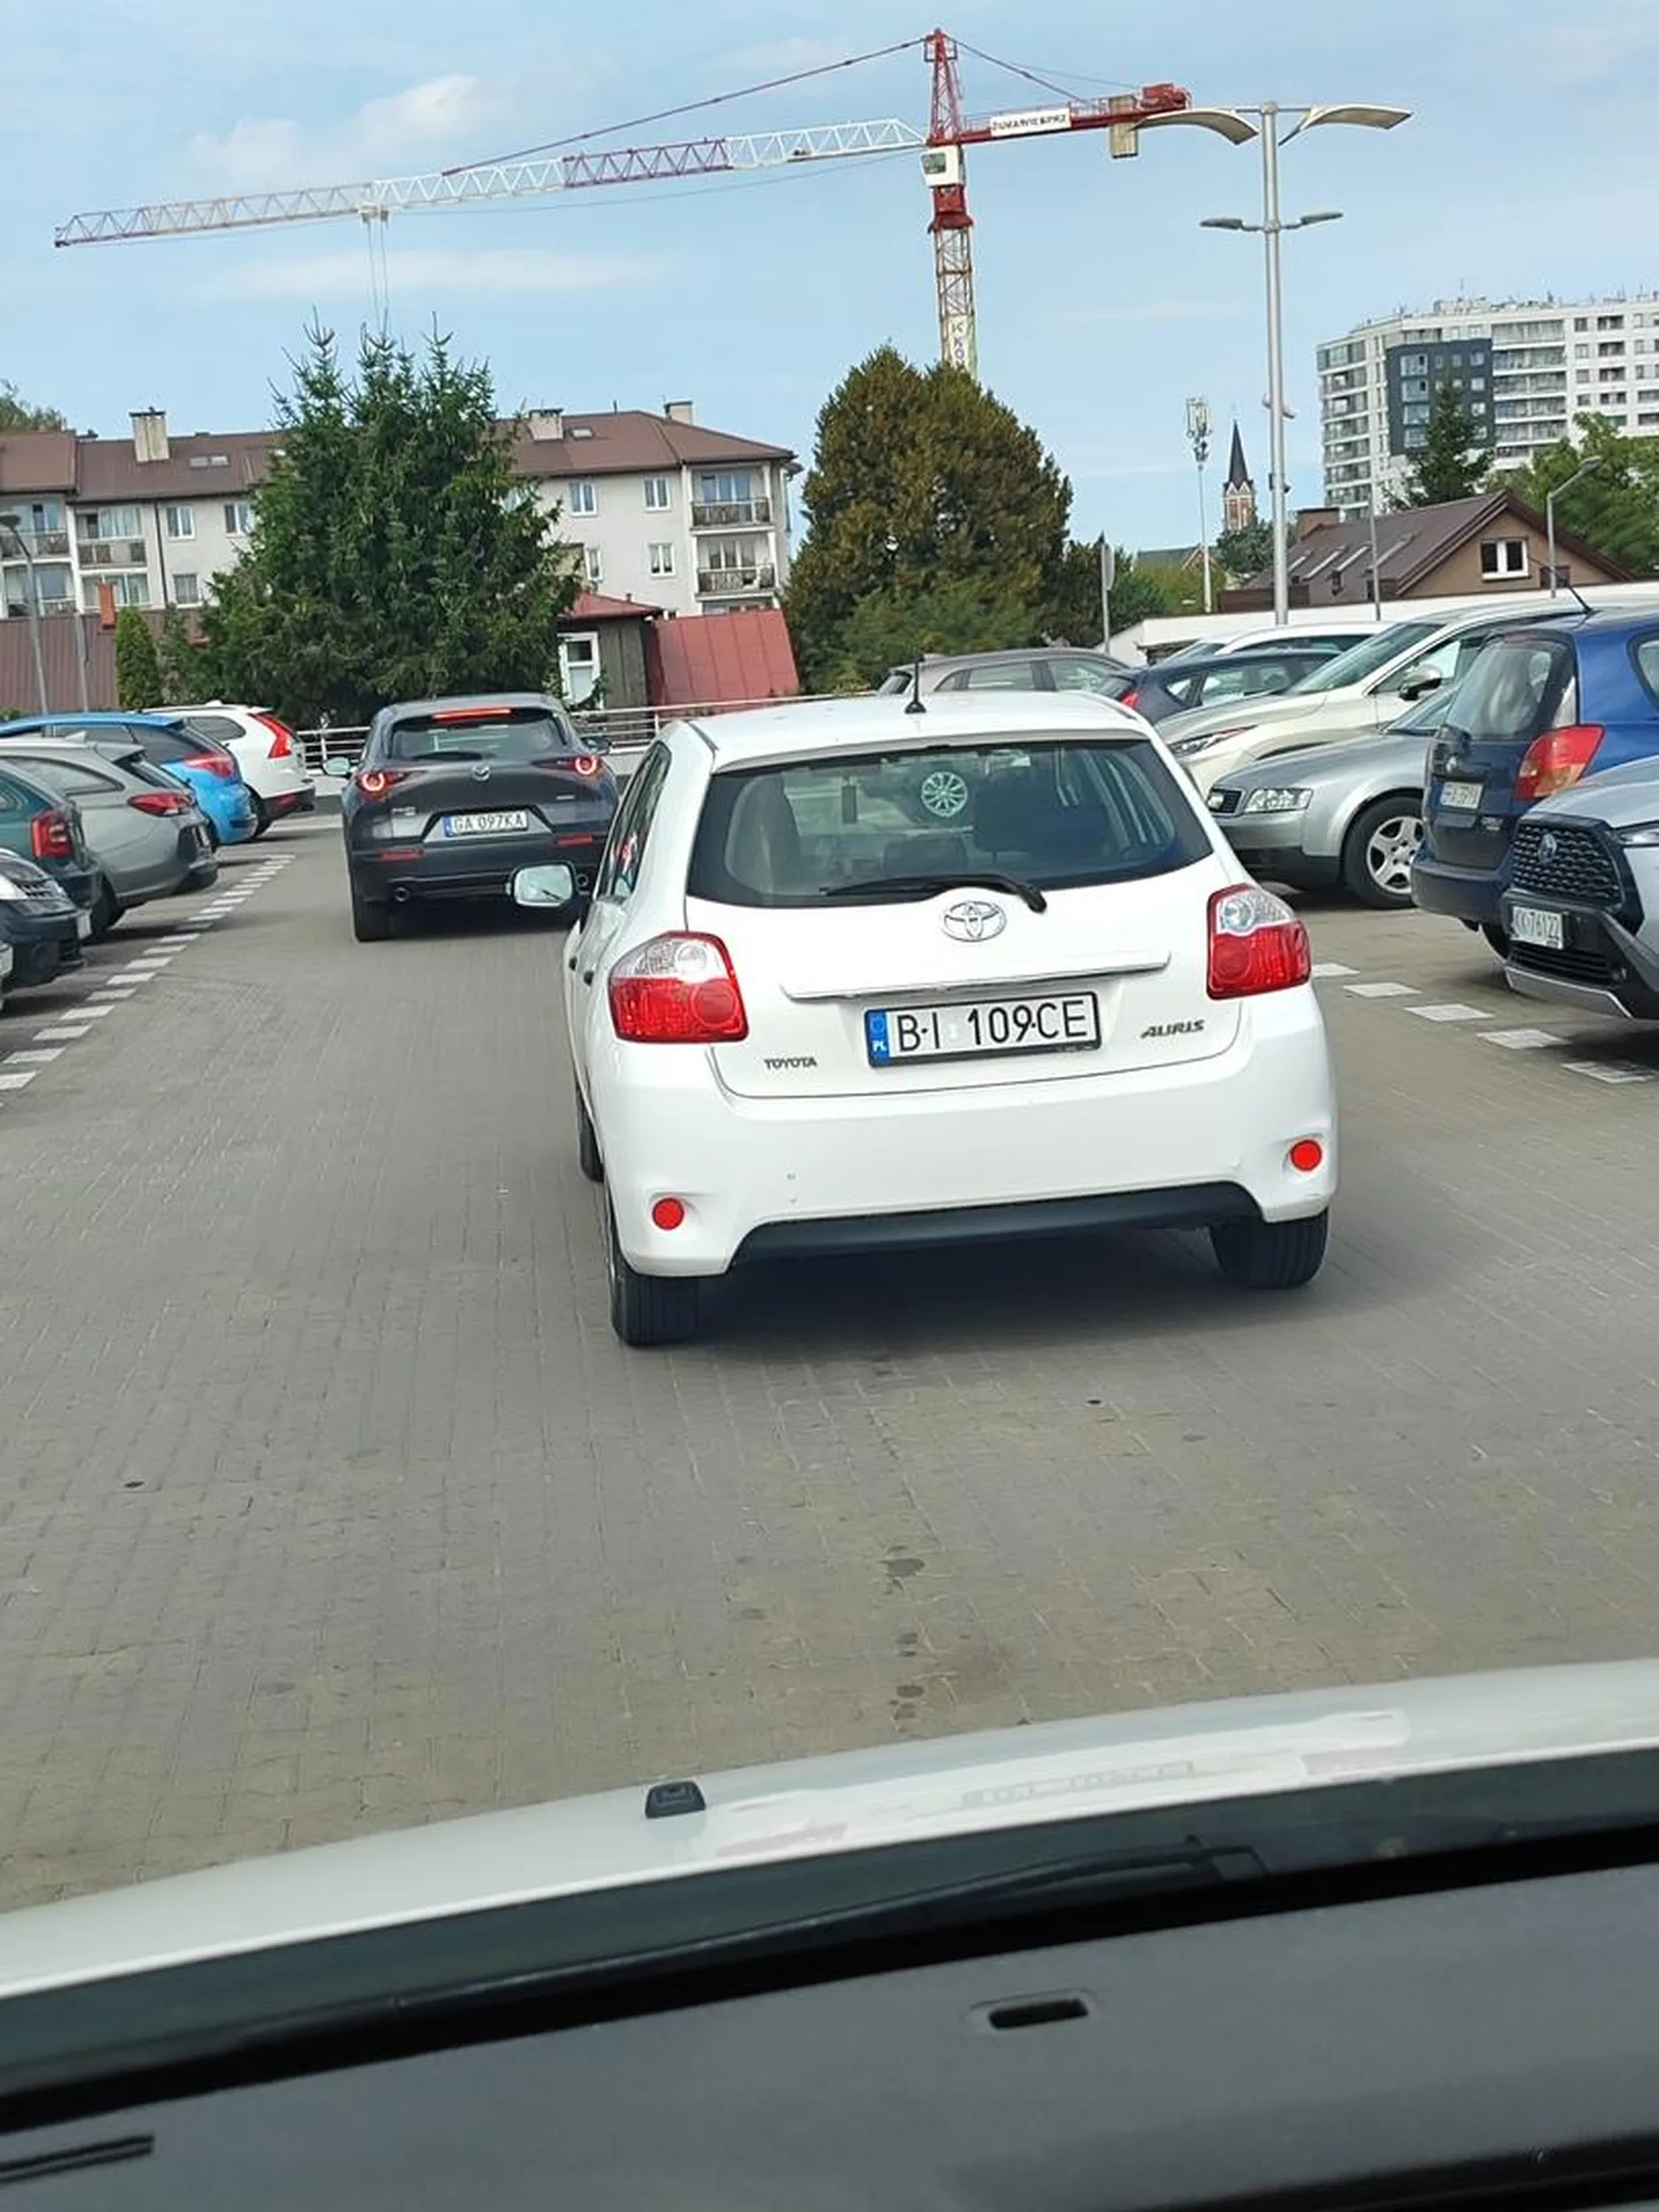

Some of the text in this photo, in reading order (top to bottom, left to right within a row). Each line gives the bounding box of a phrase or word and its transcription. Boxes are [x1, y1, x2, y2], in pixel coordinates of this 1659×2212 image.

[967, 999, 1087, 1046] 109CE
[1139, 1018, 1205, 1040] AURIS
[763, 1056, 818, 1071] TOYOTA
